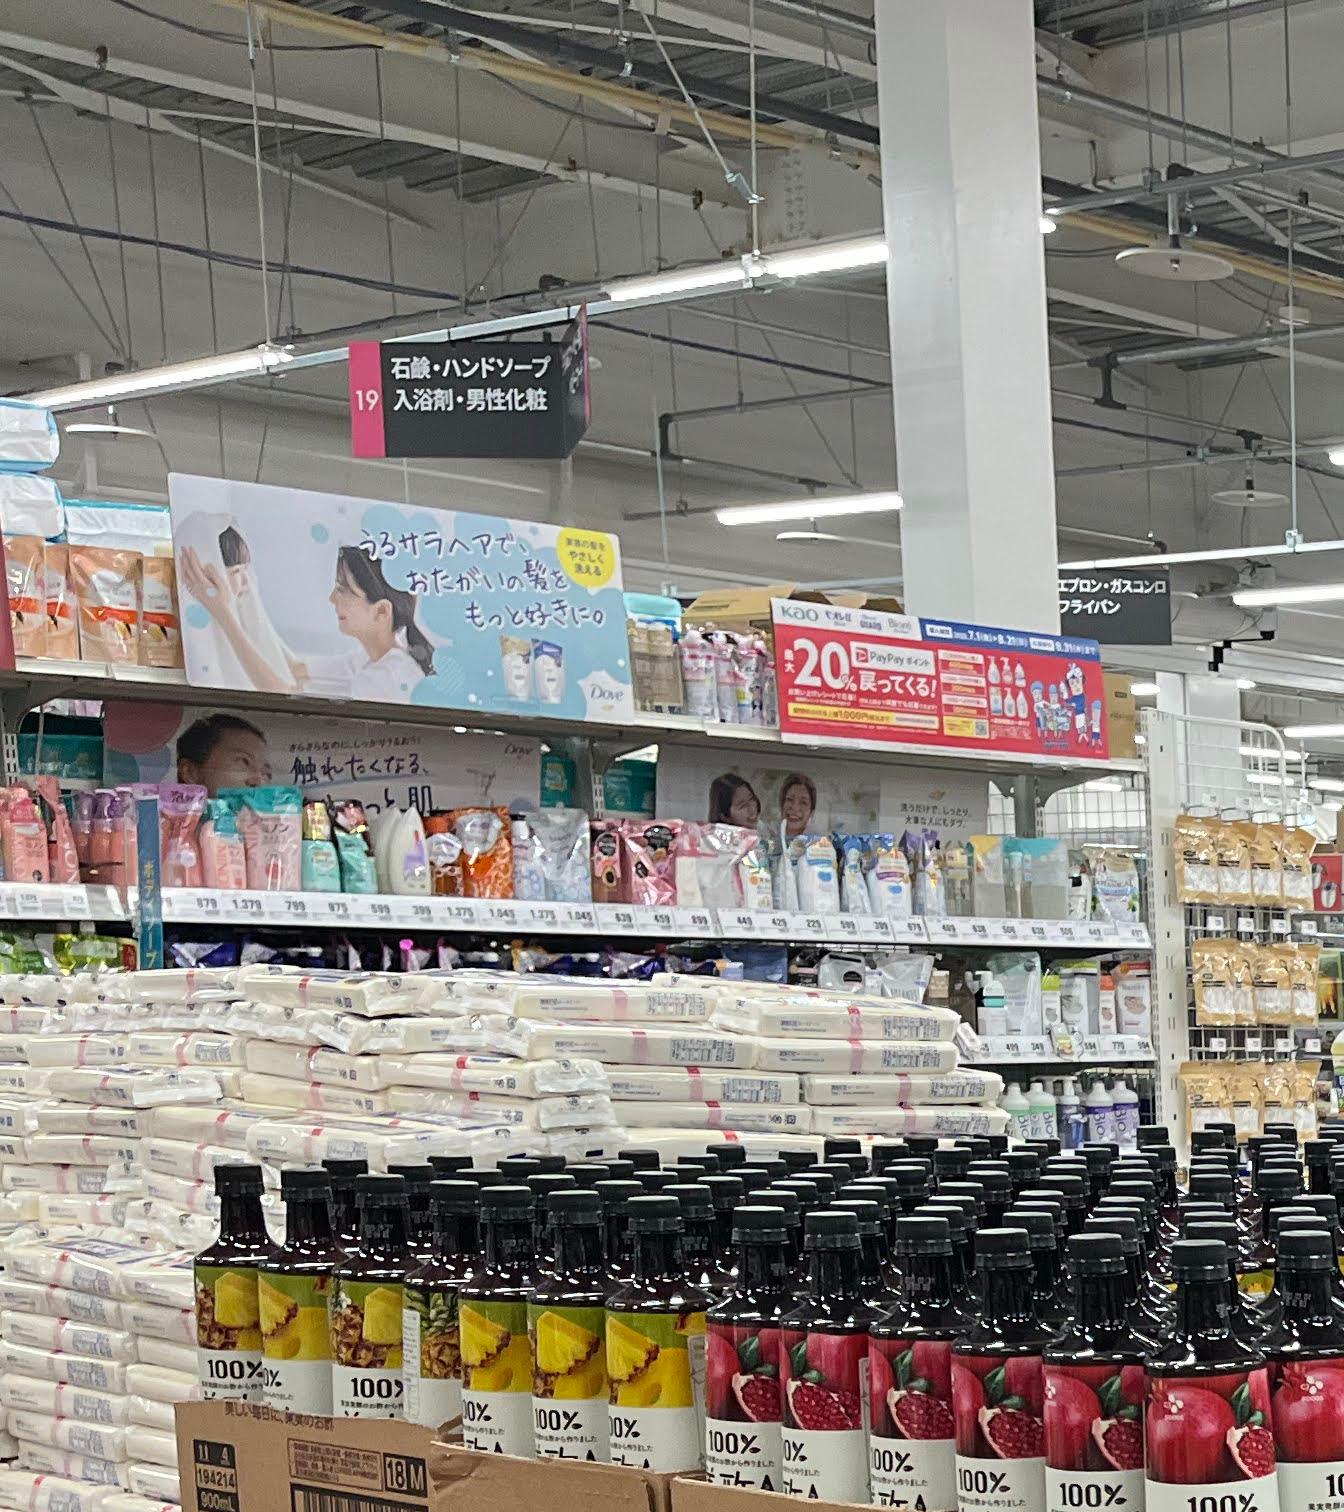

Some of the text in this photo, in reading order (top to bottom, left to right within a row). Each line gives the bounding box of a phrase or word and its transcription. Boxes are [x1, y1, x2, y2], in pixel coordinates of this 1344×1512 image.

[391, 356, 551, 379] 石鹸・ハンドソープ
[356, 390, 379, 410] 19
[393, 389, 548, 411] 入浴剤・男性化粧
[407, 560, 568, 592] おたがいの髪を
[466, 600, 604, 628] もっと好きに。
[1059, 599, 1121, 614] フライパン
[870, 651, 904, 665] PayPay
[591, 683, 624, 701] Dove
[198, 1468, 235, 1488] 194214
[387, 1457, 403, 1487] 18
[411, 1465, 423, 1490] M
[200, 1492, 235, 1511] 900mL
[1059, 1483, 1127, 1508] 100%
